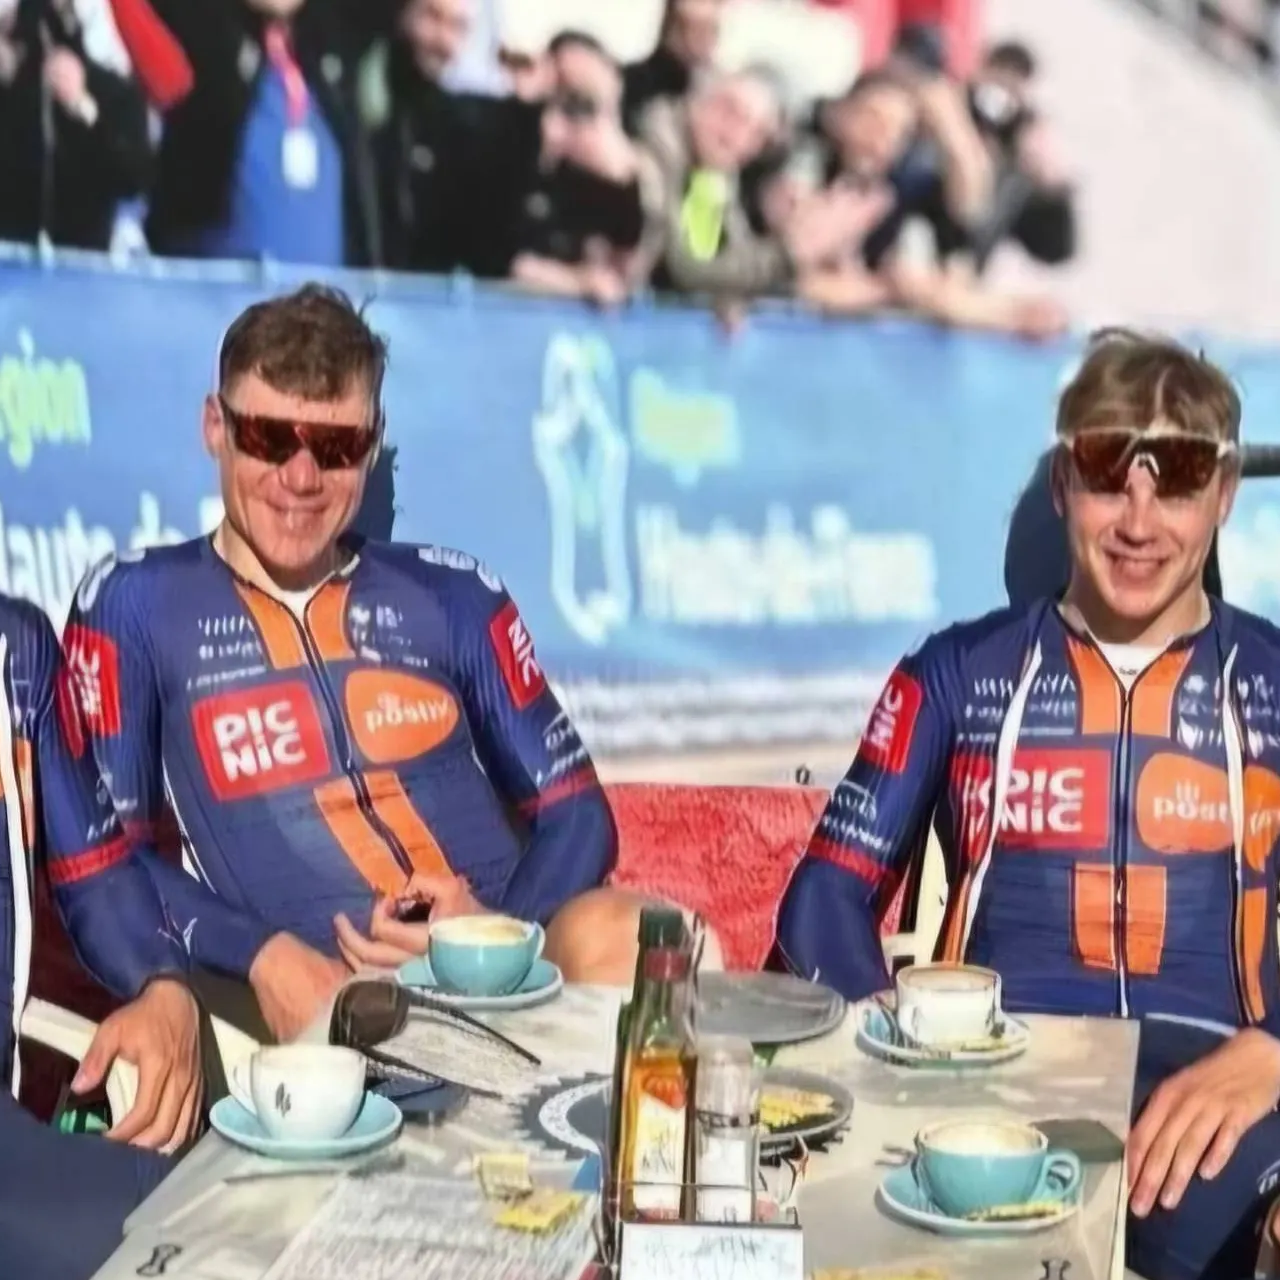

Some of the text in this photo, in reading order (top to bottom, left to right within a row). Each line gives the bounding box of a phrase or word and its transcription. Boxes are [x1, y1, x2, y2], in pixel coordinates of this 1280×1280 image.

[213, 700, 297, 750] PIC
[223, 732, 307, 783] NIC
[999, 801, 1084, 834] NIC
